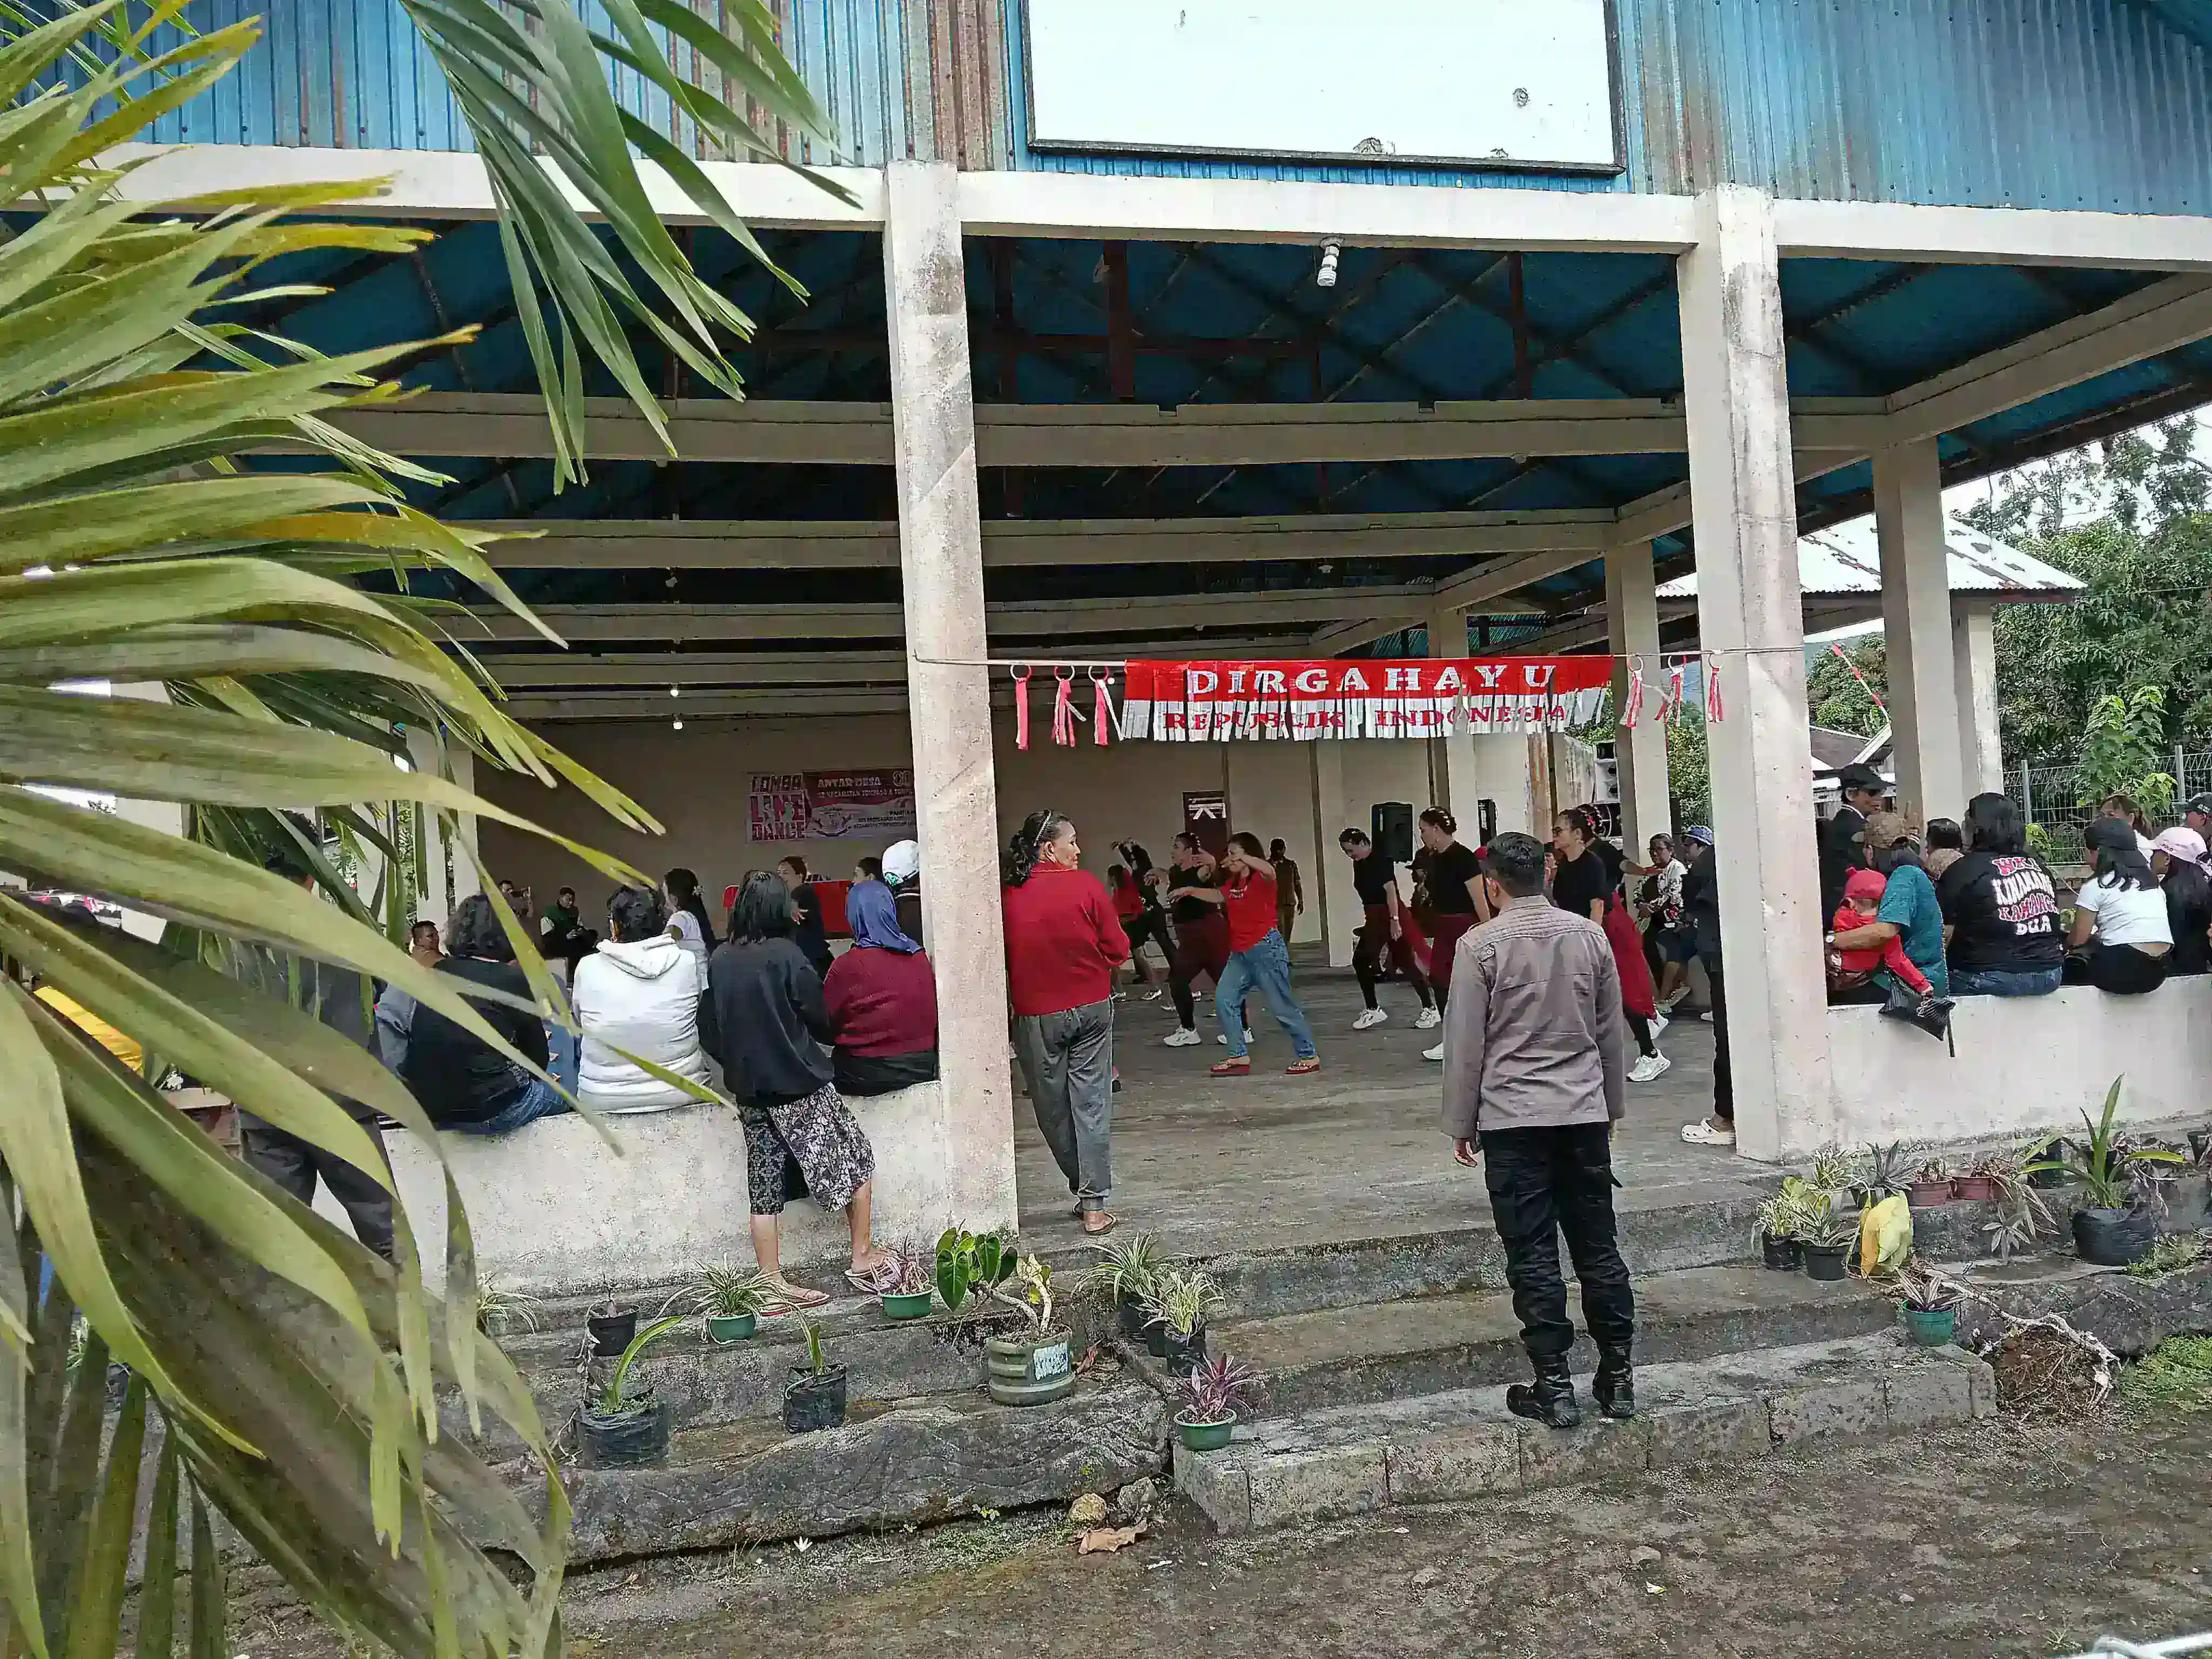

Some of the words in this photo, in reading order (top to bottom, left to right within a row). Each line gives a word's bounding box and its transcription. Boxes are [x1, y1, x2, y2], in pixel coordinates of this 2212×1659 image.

[1188, 665, 1556, 694] DIRGAHAYU
[1163, 710, 1345, 730] REPUBLIK
[818, 778, 853, 788] ANTAR
[855, 776, 882, 787] DESA
[751, 822, 806, 840] DANCE
[2015, 915, 2052, 935] DUA
